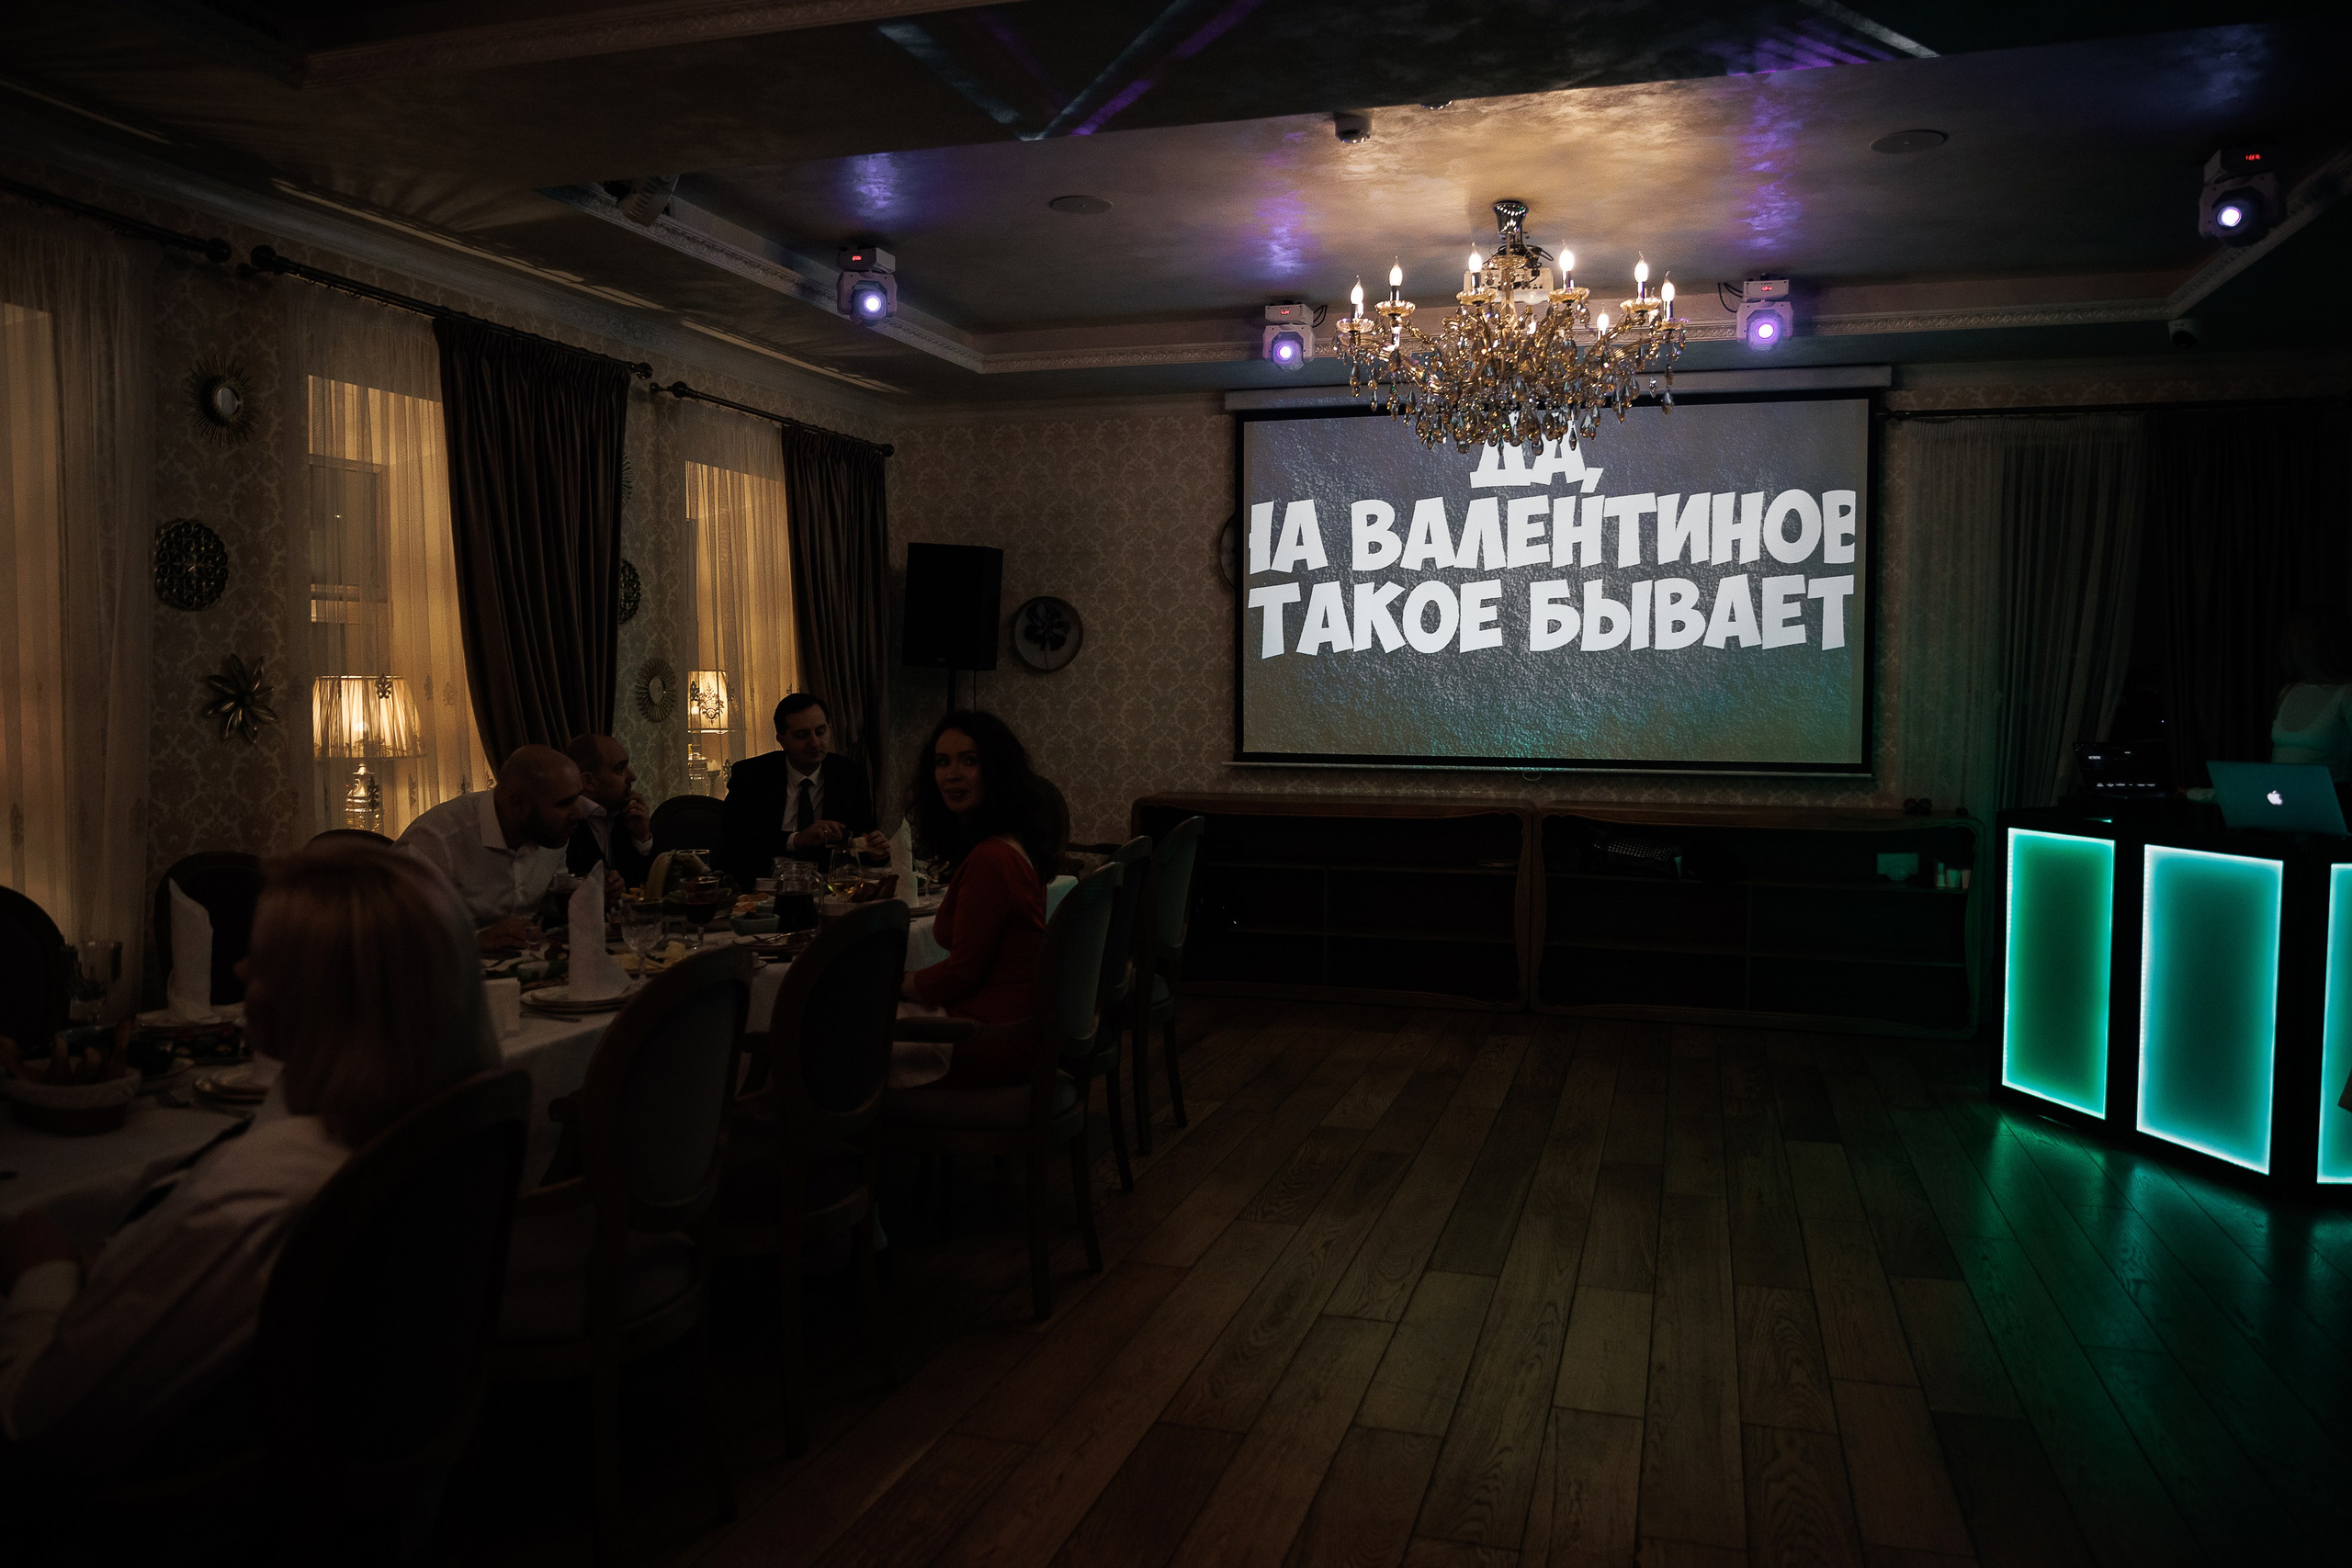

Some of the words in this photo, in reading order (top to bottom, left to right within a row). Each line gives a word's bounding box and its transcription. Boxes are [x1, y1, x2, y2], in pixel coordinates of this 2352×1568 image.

[1351, 489, 1856, 571] ВАЛЕНТИНОВ
[1248, 579, 1503, 660] ТАКОЕ
[1528, 572, 1855, 652] БЫВАЕТ
